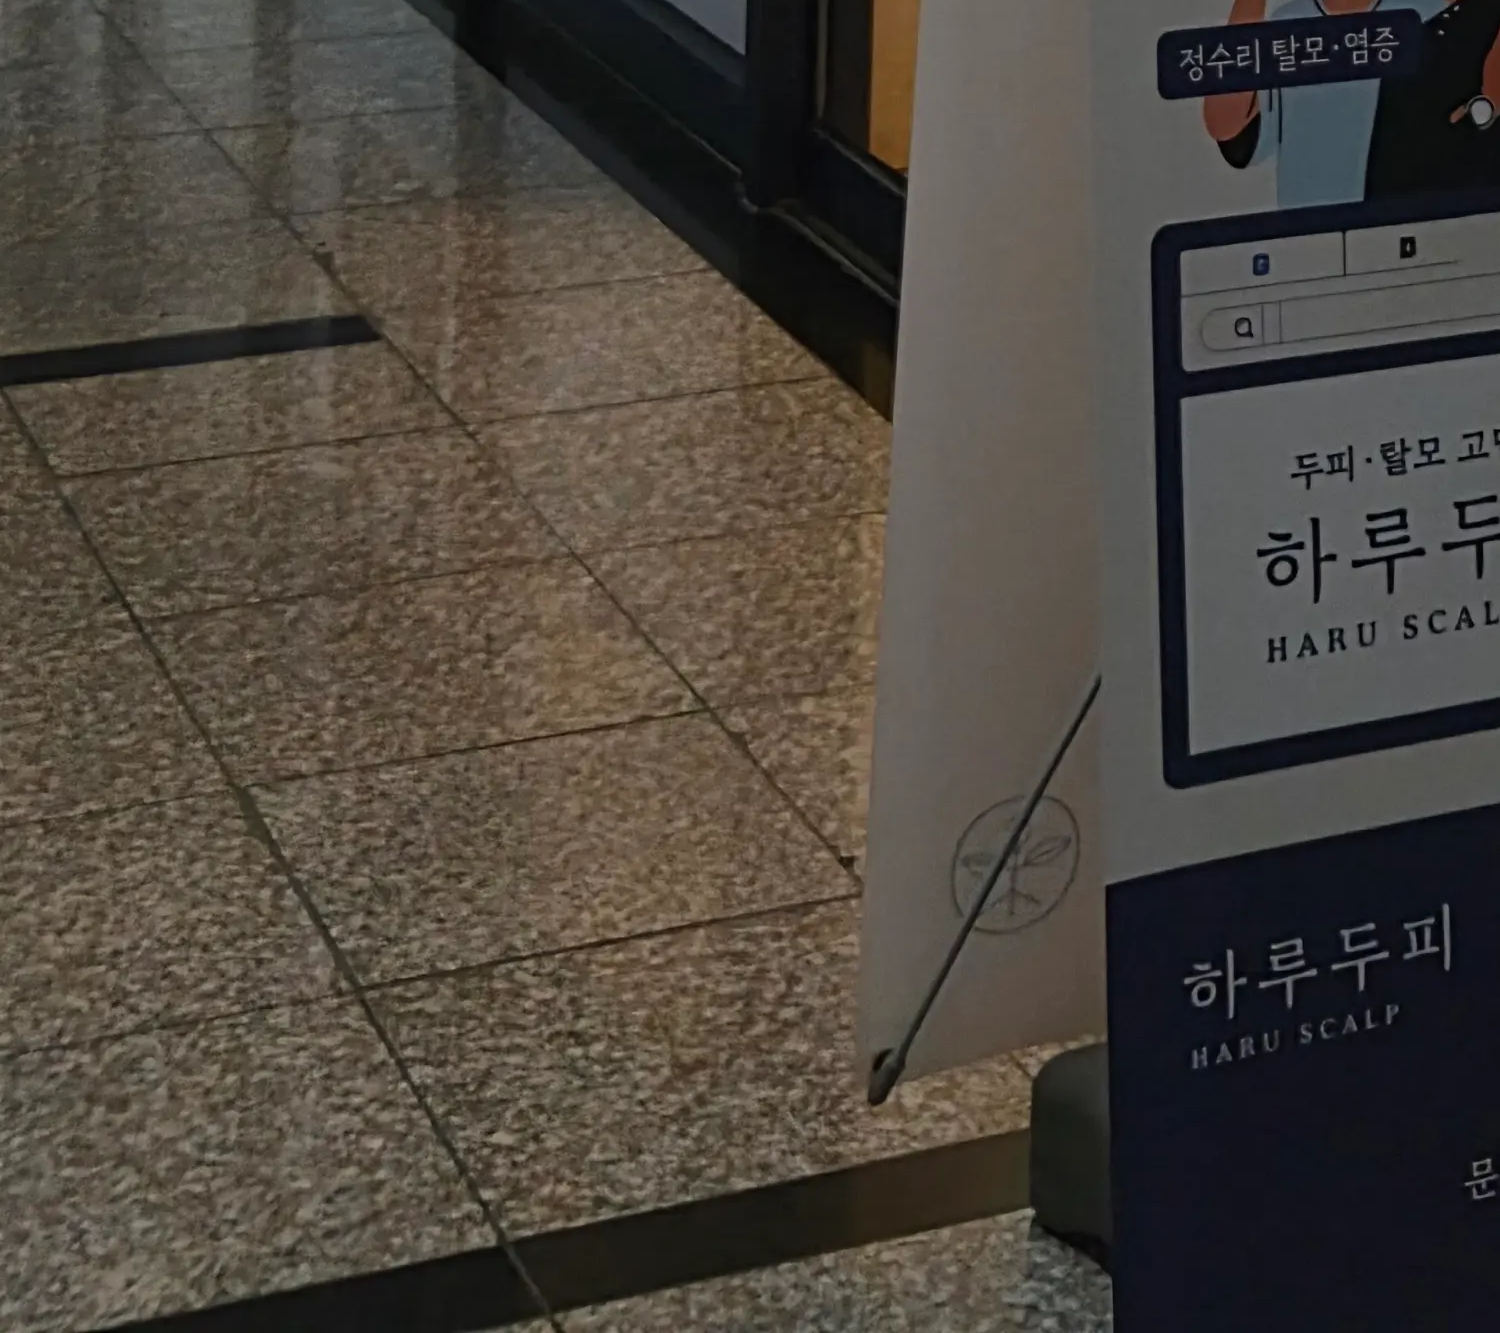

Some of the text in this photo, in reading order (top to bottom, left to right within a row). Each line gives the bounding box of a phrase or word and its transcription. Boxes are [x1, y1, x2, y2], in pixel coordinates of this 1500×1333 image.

[1179, 37, 1261, 81] 정수리
[1266, 620, 1378, 663] HARU
[1184, 903, 1450, 1019] 하루두피
[1191, 1004, 1400, 1069] HARU SCALP
